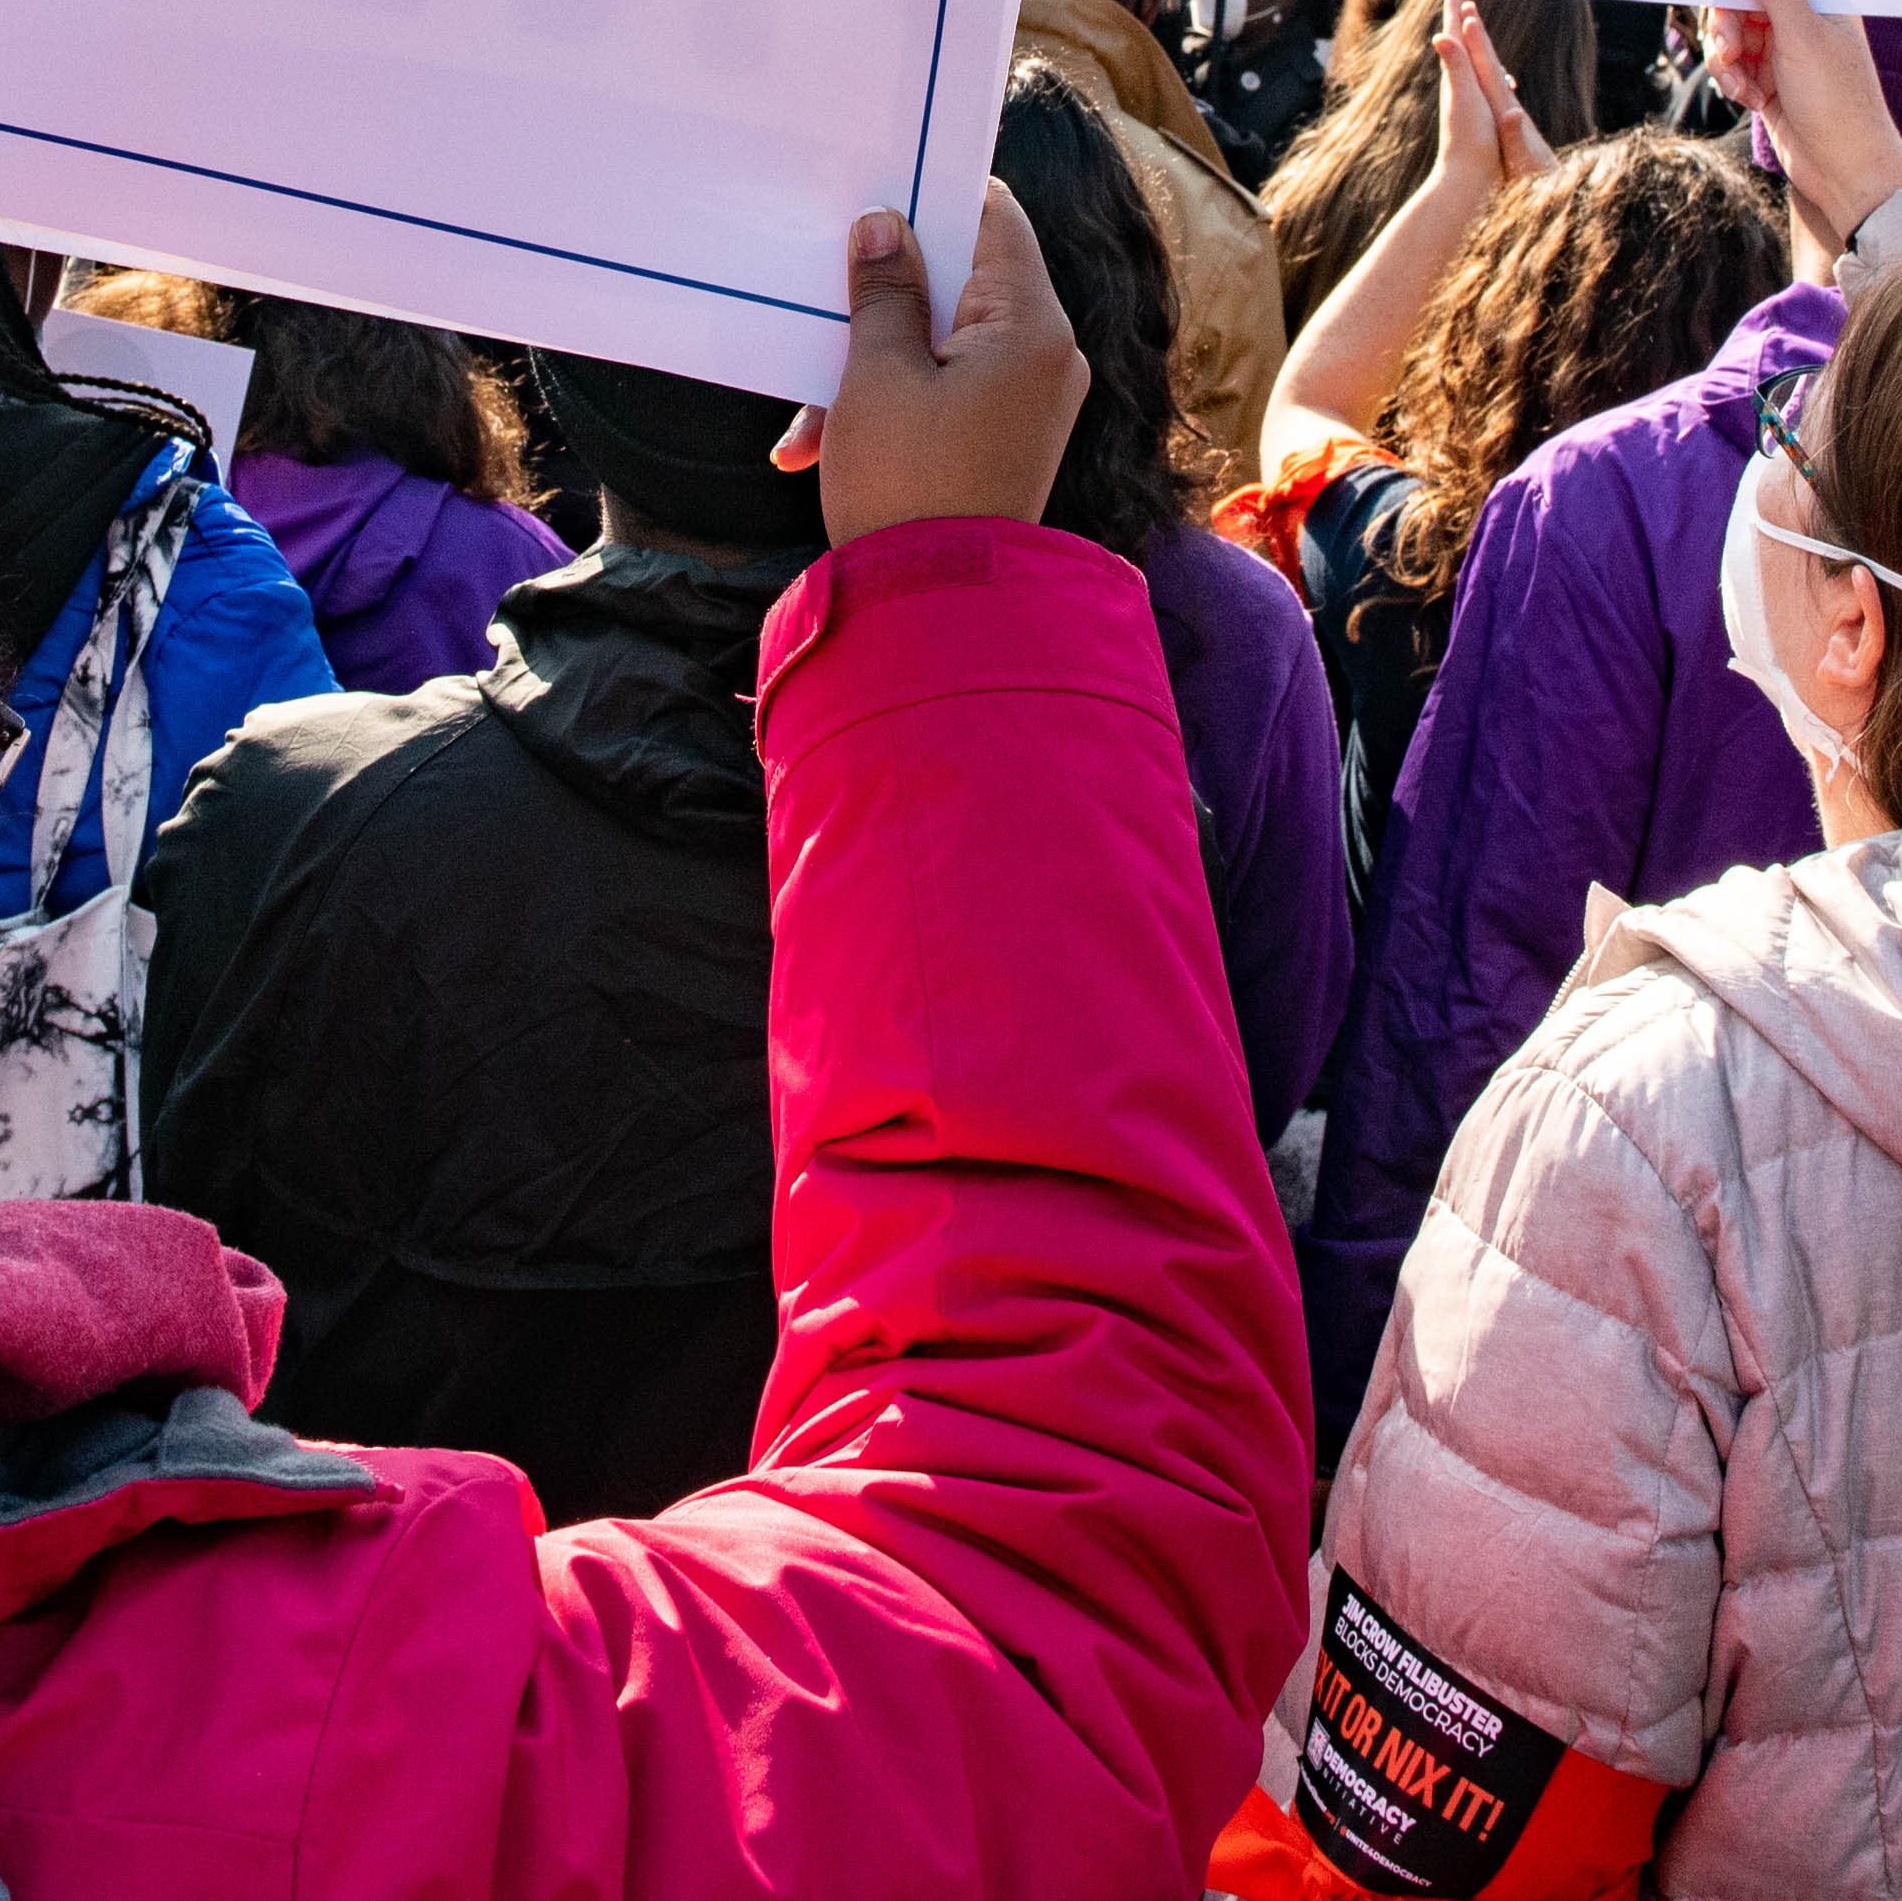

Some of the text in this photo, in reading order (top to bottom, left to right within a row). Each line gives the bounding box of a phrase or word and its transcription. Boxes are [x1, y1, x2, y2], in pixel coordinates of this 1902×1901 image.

[1334, 1615, 1495, 1759] BLOCKS DEMOCRACY
[1341, 1592, 1504, 1742] JIM CROW FILIBUSTER
[1321, 1765, 1404, 1846] NITIATIVE
[1322, 1669, 1353, 1722] IT
[1340, 1692, 1384, 1760] OR
[1372, 1725, 1453, 1810] NIX
[1440, 1775, 1507, 1843] IT!
[1322, 1742, 1418, 1834] DEMOCRACY
